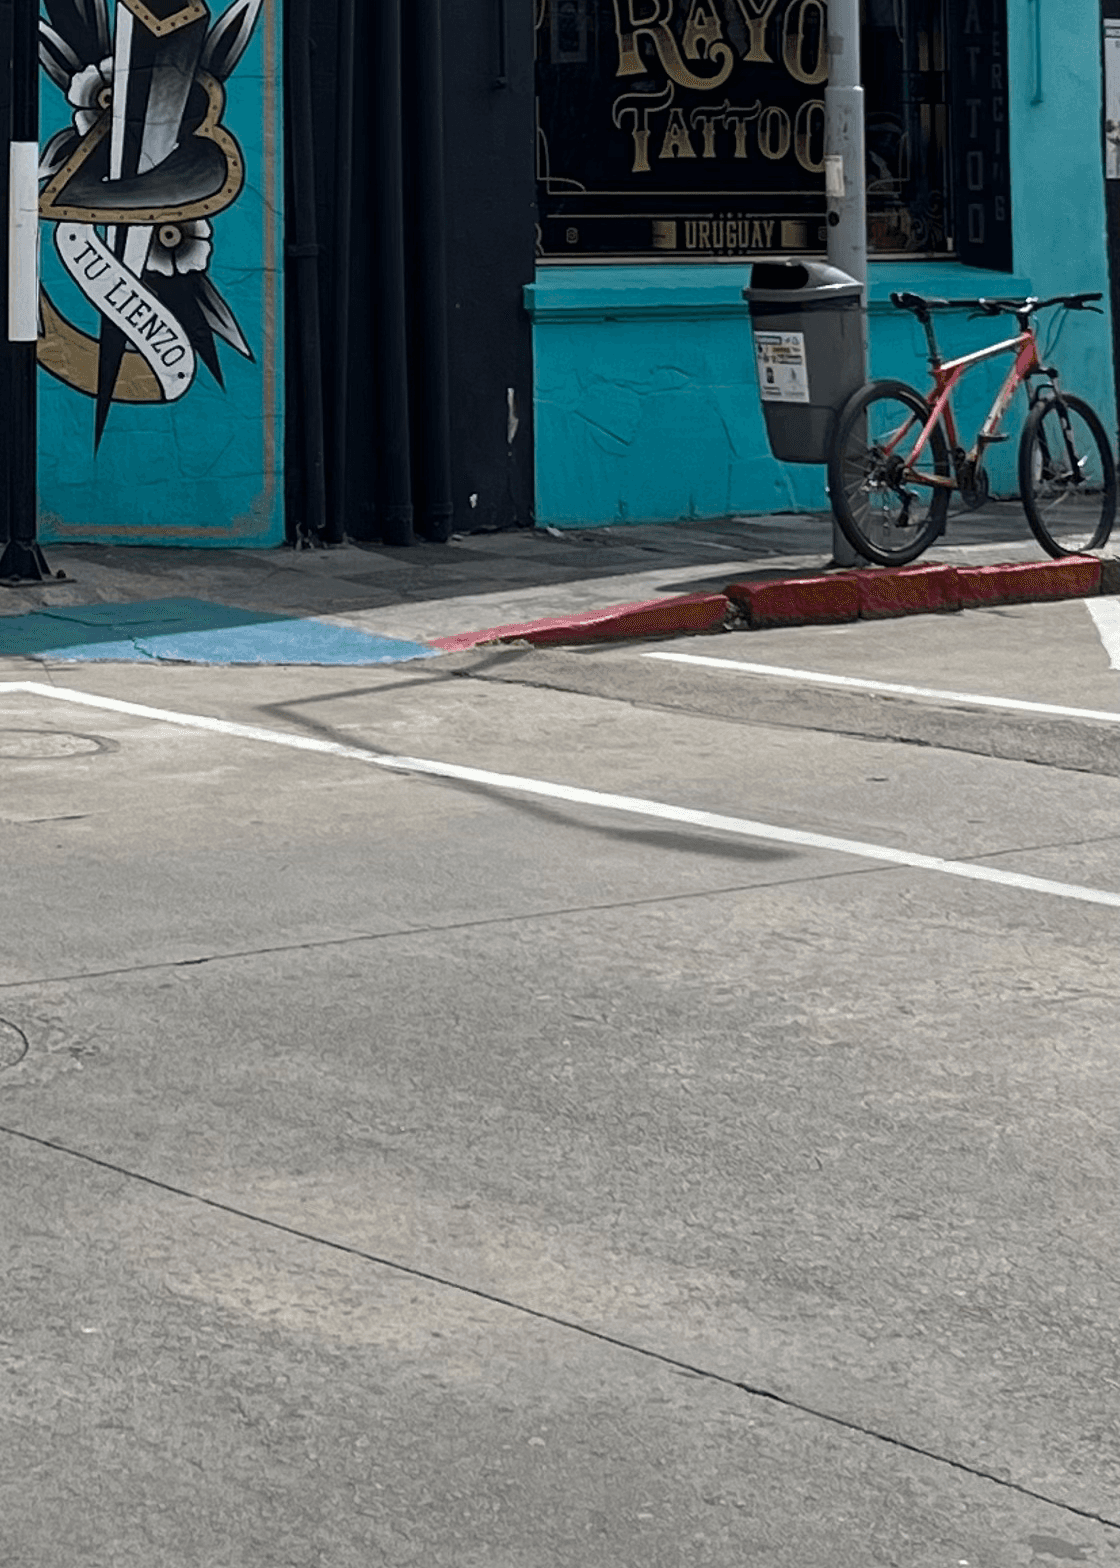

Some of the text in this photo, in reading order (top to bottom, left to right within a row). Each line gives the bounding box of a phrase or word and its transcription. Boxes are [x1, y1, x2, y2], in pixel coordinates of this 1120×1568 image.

[684, 220, 776, 249] URUGUAY
[73, 240, 185, 367] TU LIENZO
